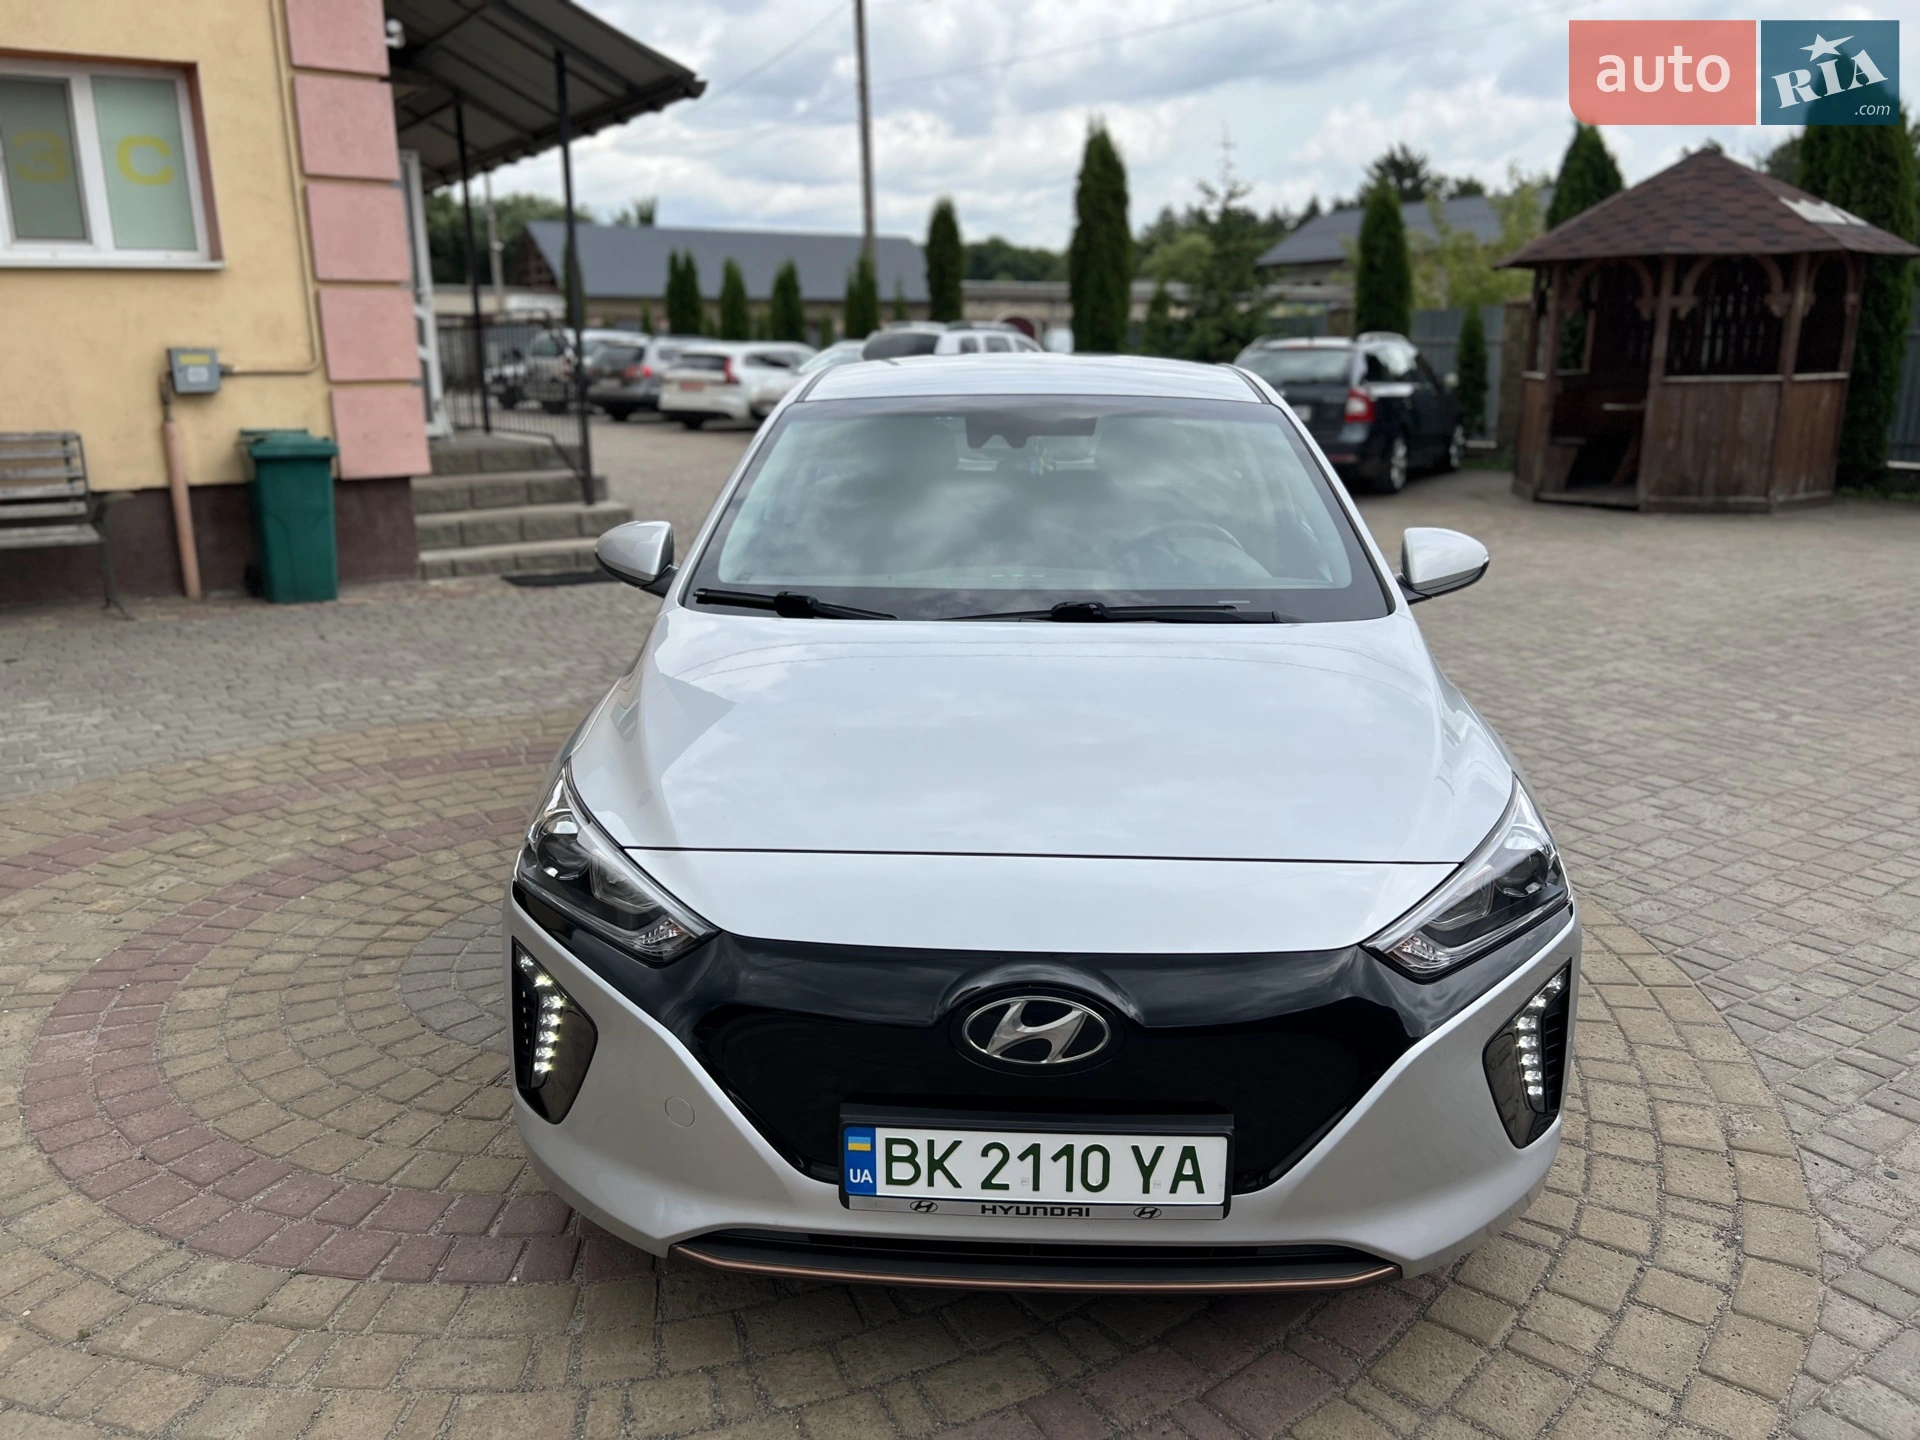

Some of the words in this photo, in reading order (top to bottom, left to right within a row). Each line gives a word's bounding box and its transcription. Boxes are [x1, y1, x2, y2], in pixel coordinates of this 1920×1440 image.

[885, 1137, 963, 1189] BK
[980, 1141, 1111, 1193] 2110
[1130, 1145, 1205, 1195] YA
[849, 1168, 873, 1184] UA
[980, 1204, 1090, 1217] HYUNDAI
